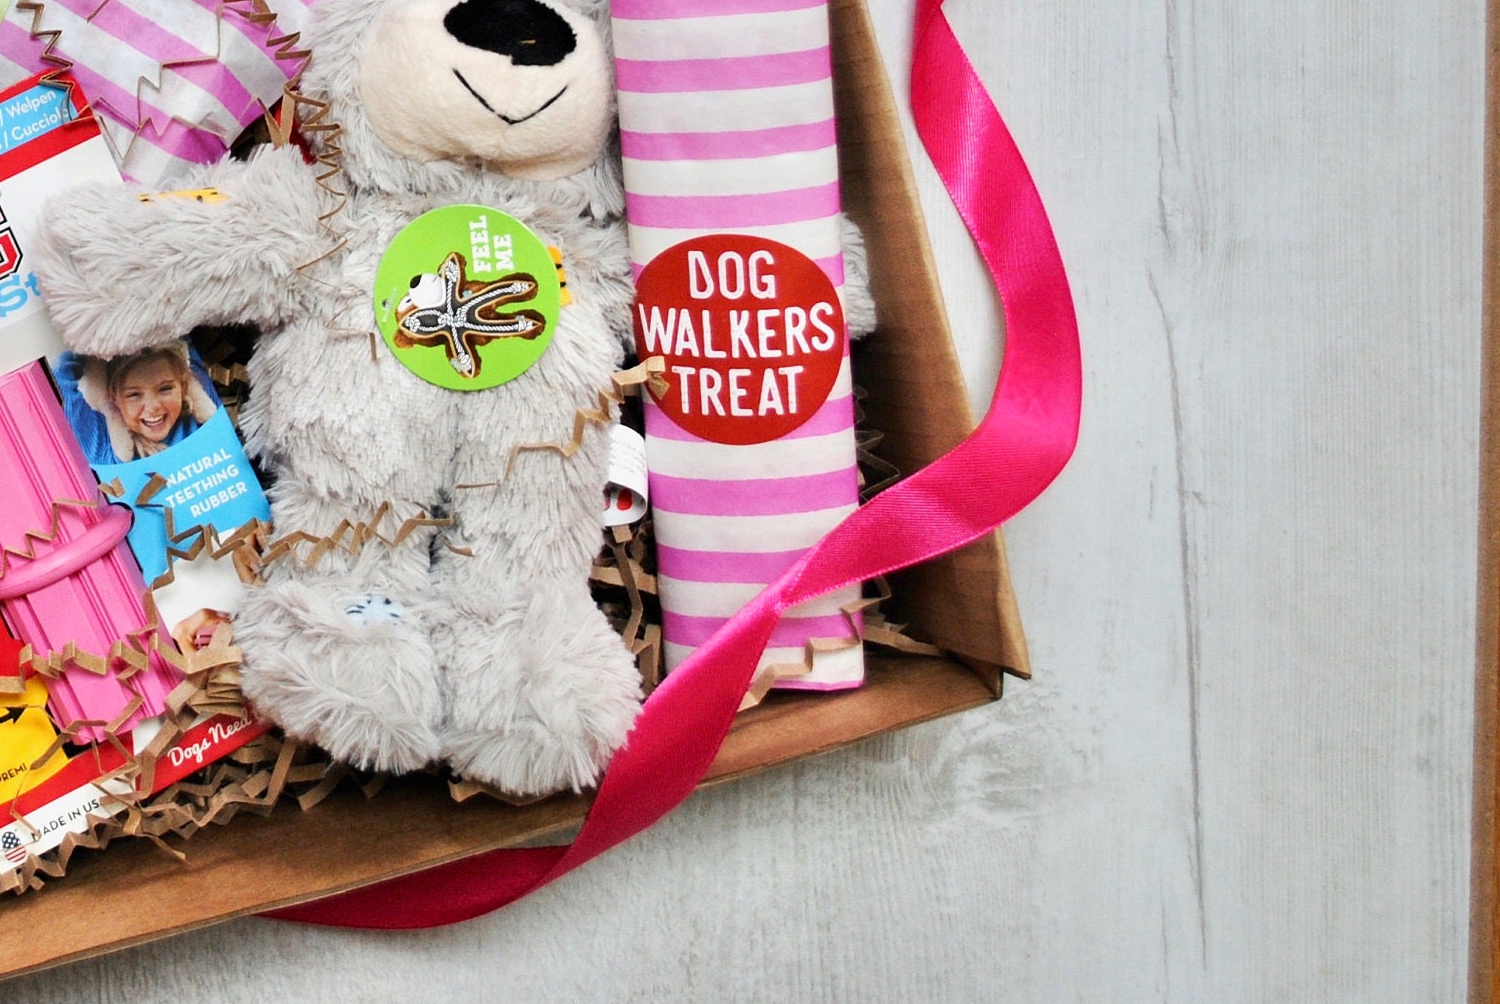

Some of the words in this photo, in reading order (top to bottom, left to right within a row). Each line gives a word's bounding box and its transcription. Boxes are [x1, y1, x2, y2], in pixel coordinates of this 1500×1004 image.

[0, 108, 4, 126] /
[5, 90, 56, 118] Welpen
[4, 131, 8, 148] /
[472, 215, 488, 273] FEEL
[494, 234, 514, 270] ME
[687, 250, 776, 300] DOG
[638, 301, 836, 359] WALKERS
[671, 366, 804, 417] TREAT
[165, 464, 240, 508] TEETHING
[166, 448, 232, 488] NATURAL
[189, 480, 248, 519] RUBBER
[166, 739, 212, 768] Dogs
[208, 709, 252, 744] Need
[69, 807, 82, 822] IN
[85, 798, 100, 814] US
